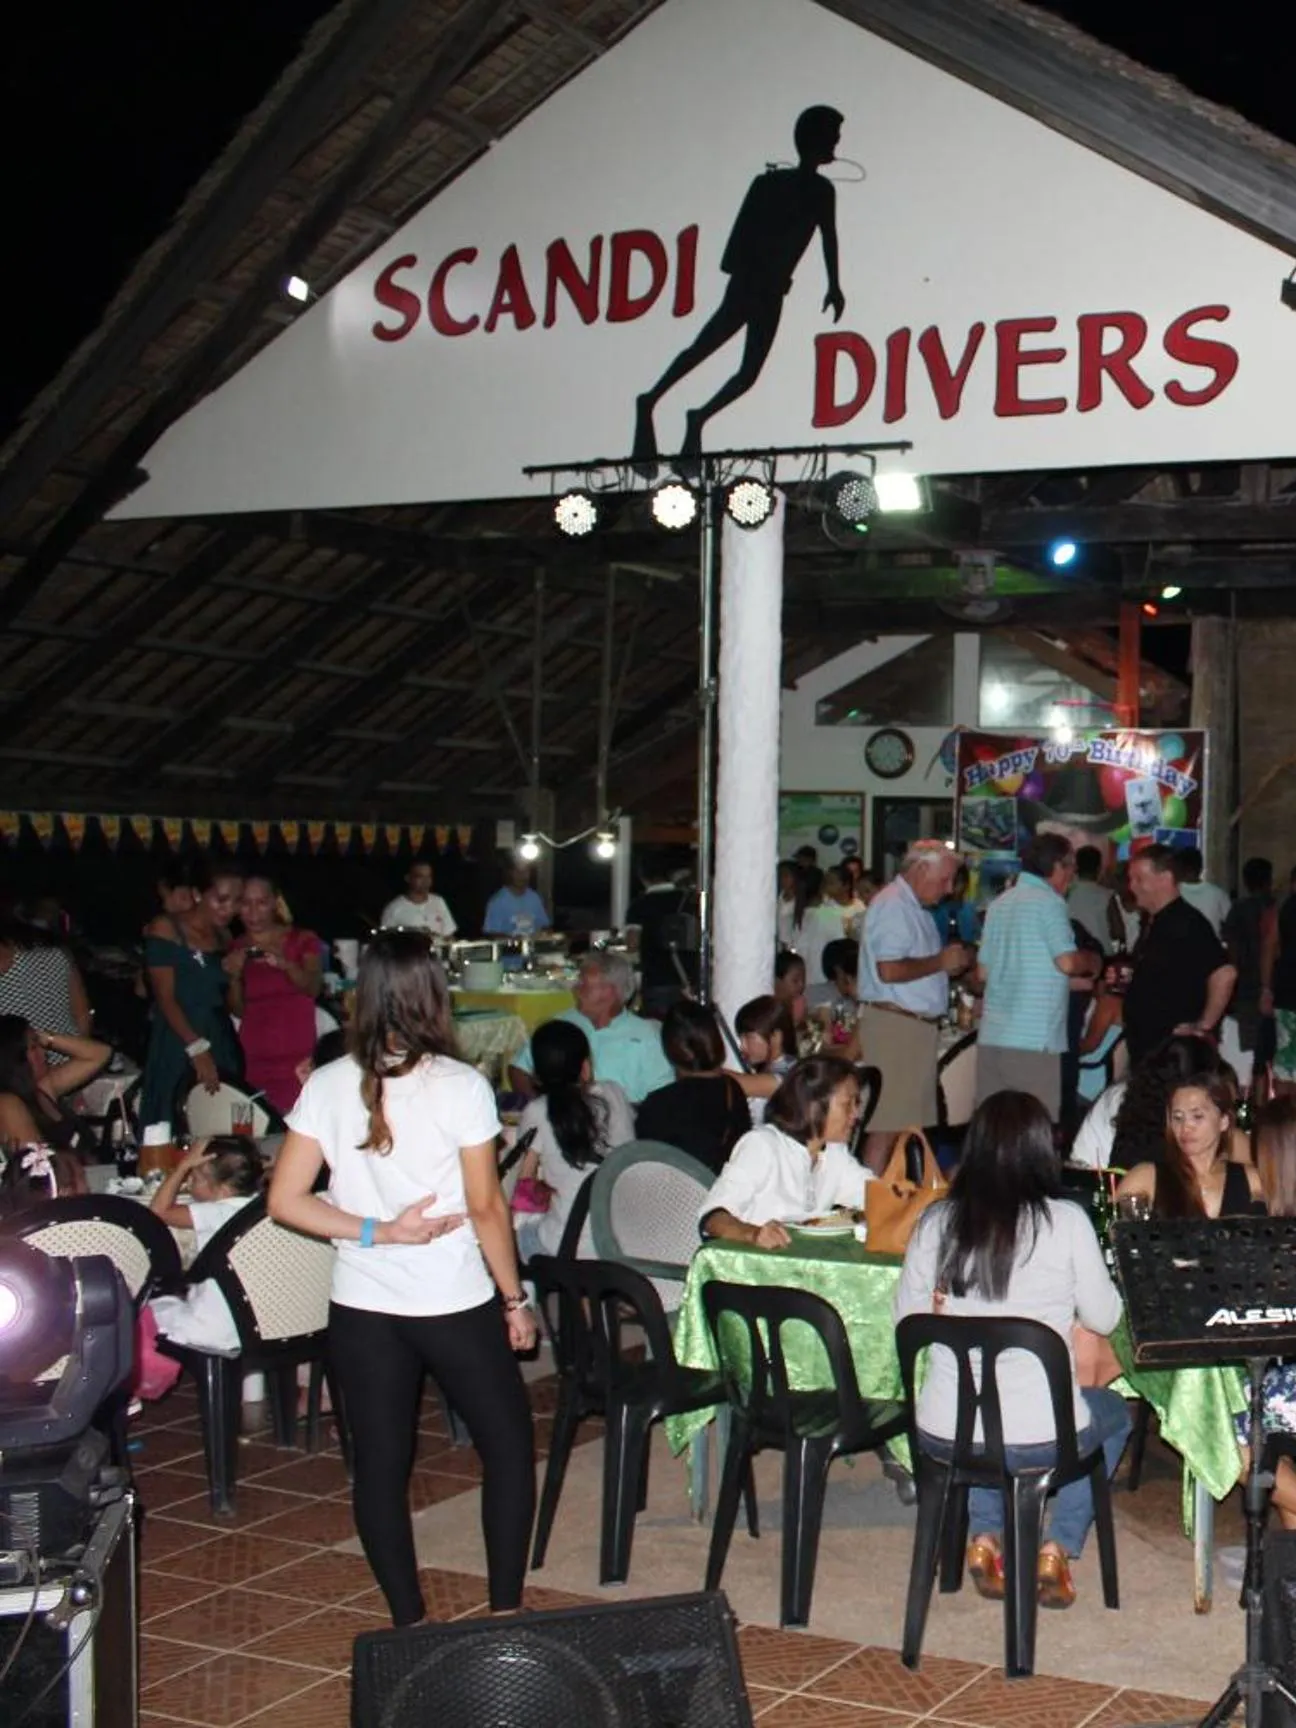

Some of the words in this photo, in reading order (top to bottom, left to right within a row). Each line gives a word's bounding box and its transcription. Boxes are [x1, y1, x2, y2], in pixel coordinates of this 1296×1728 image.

[373, 223, 699, 342] SCANDI
[811, 303, 1240, 428] DIVERS
[966, 748, 1037, 790] Happy
